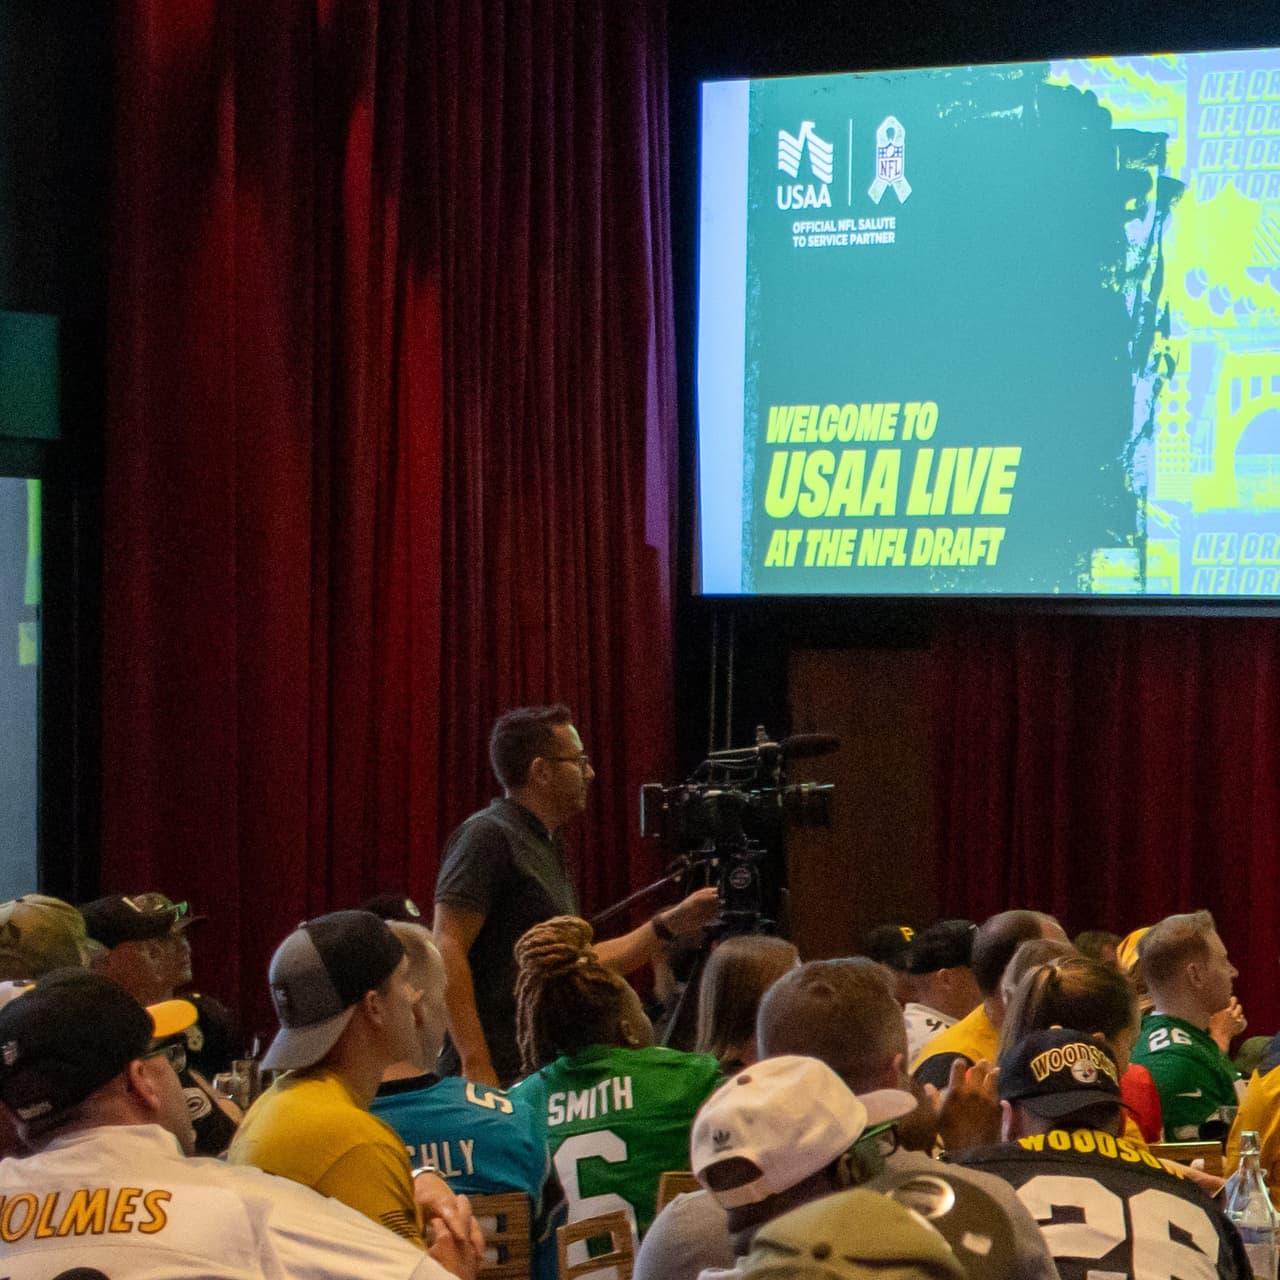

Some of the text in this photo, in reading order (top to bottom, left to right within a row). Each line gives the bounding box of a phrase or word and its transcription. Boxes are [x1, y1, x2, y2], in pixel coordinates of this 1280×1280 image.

[1199, 70, 1244, 103] NFL
[1198, 104, 1244, 137] NFL
[880, 159, 901, 178] NFL
[1198, 138, 1244, 171] NFL
[777, 184, 832, 210] USAA
[792, 217, 897, 234] OFFICIAL NFL SALUTE
[793, 231, 896, 248] TO SERVICE PARTNER
[766, 401, 939, 444] WELCOME TO
[764, 446, 1023, 518] USAA LIVE
[764, 527, 1006, 567] AT THE NFL DRAFT
[1192, 533, 1238, 565] NFL
[899, 926, 914, 941] P
[1148, 1026, 1193, 1052] 26
[1030, 1043, 1118, 1086] WOODS
[547, 1075, 633, 1127] SMITH
[407, 1139, 475, 1179] HLY
[0, 1187, 173, 1244] OLMES
